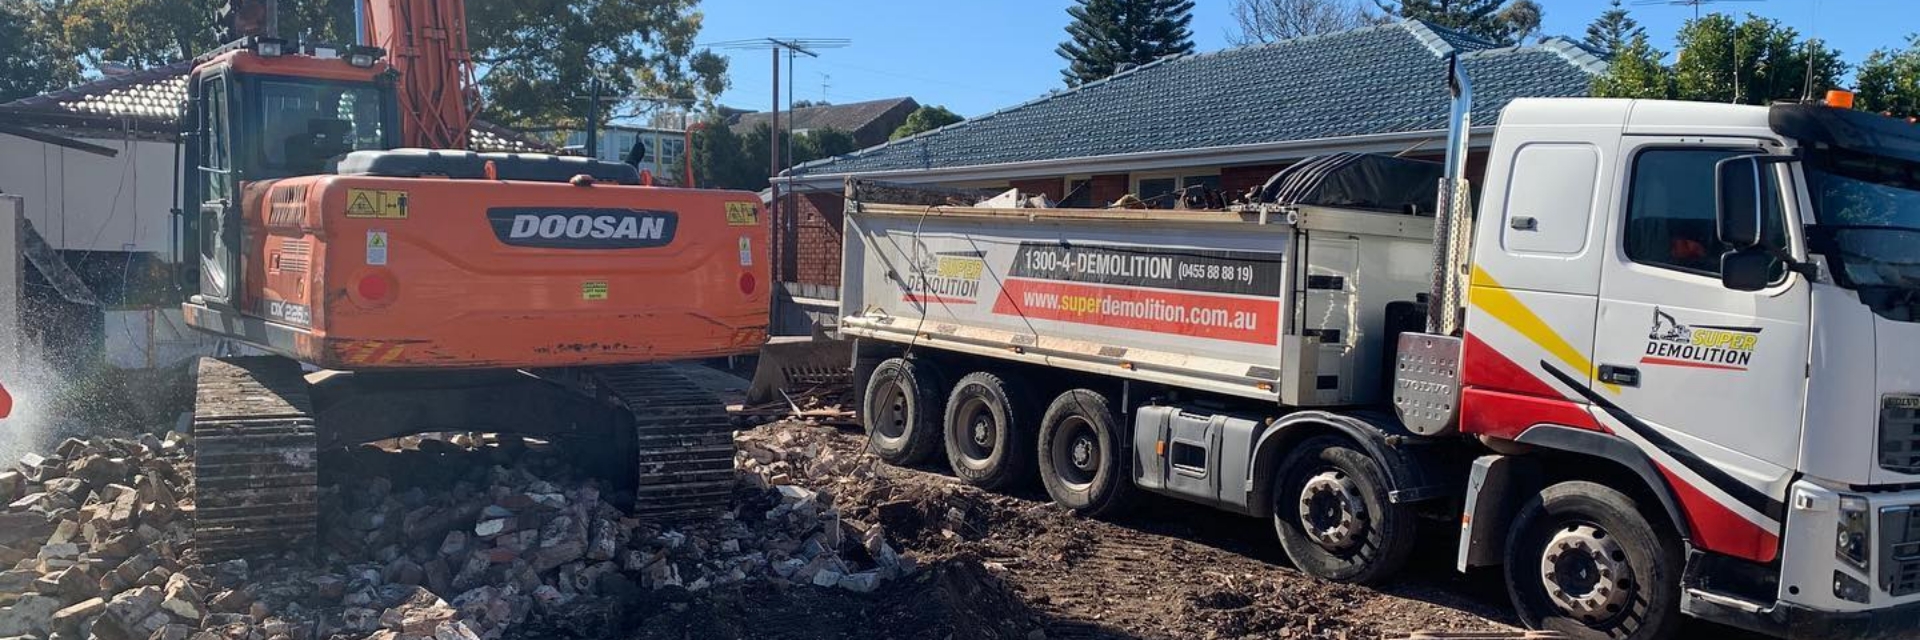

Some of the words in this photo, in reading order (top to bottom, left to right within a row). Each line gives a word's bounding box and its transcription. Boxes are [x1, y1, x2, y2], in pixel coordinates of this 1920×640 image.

[509, 214, 665, 240] DOOSAN
[937, 257, 984, 280] SUPER
[1025, 251, 1173, 280] 1300-4-DEMOLITION
[1178, 261, 1205, 281] (0455
[1207, 265, 1220, 280] 88
[1221, 266, 1235, 281] 88
[1236, 264, 1253, 285] 19)
[907, 275, 980, 298] DEMOLITION
[1023, 291, 1257, 330] www.superdemolition.com.au
[1692, 329, 1758, 351] SUPER
[1646, 341, 1752, 366] DEMOLITION
[1398, 378, 1452, 395] VOLVO
